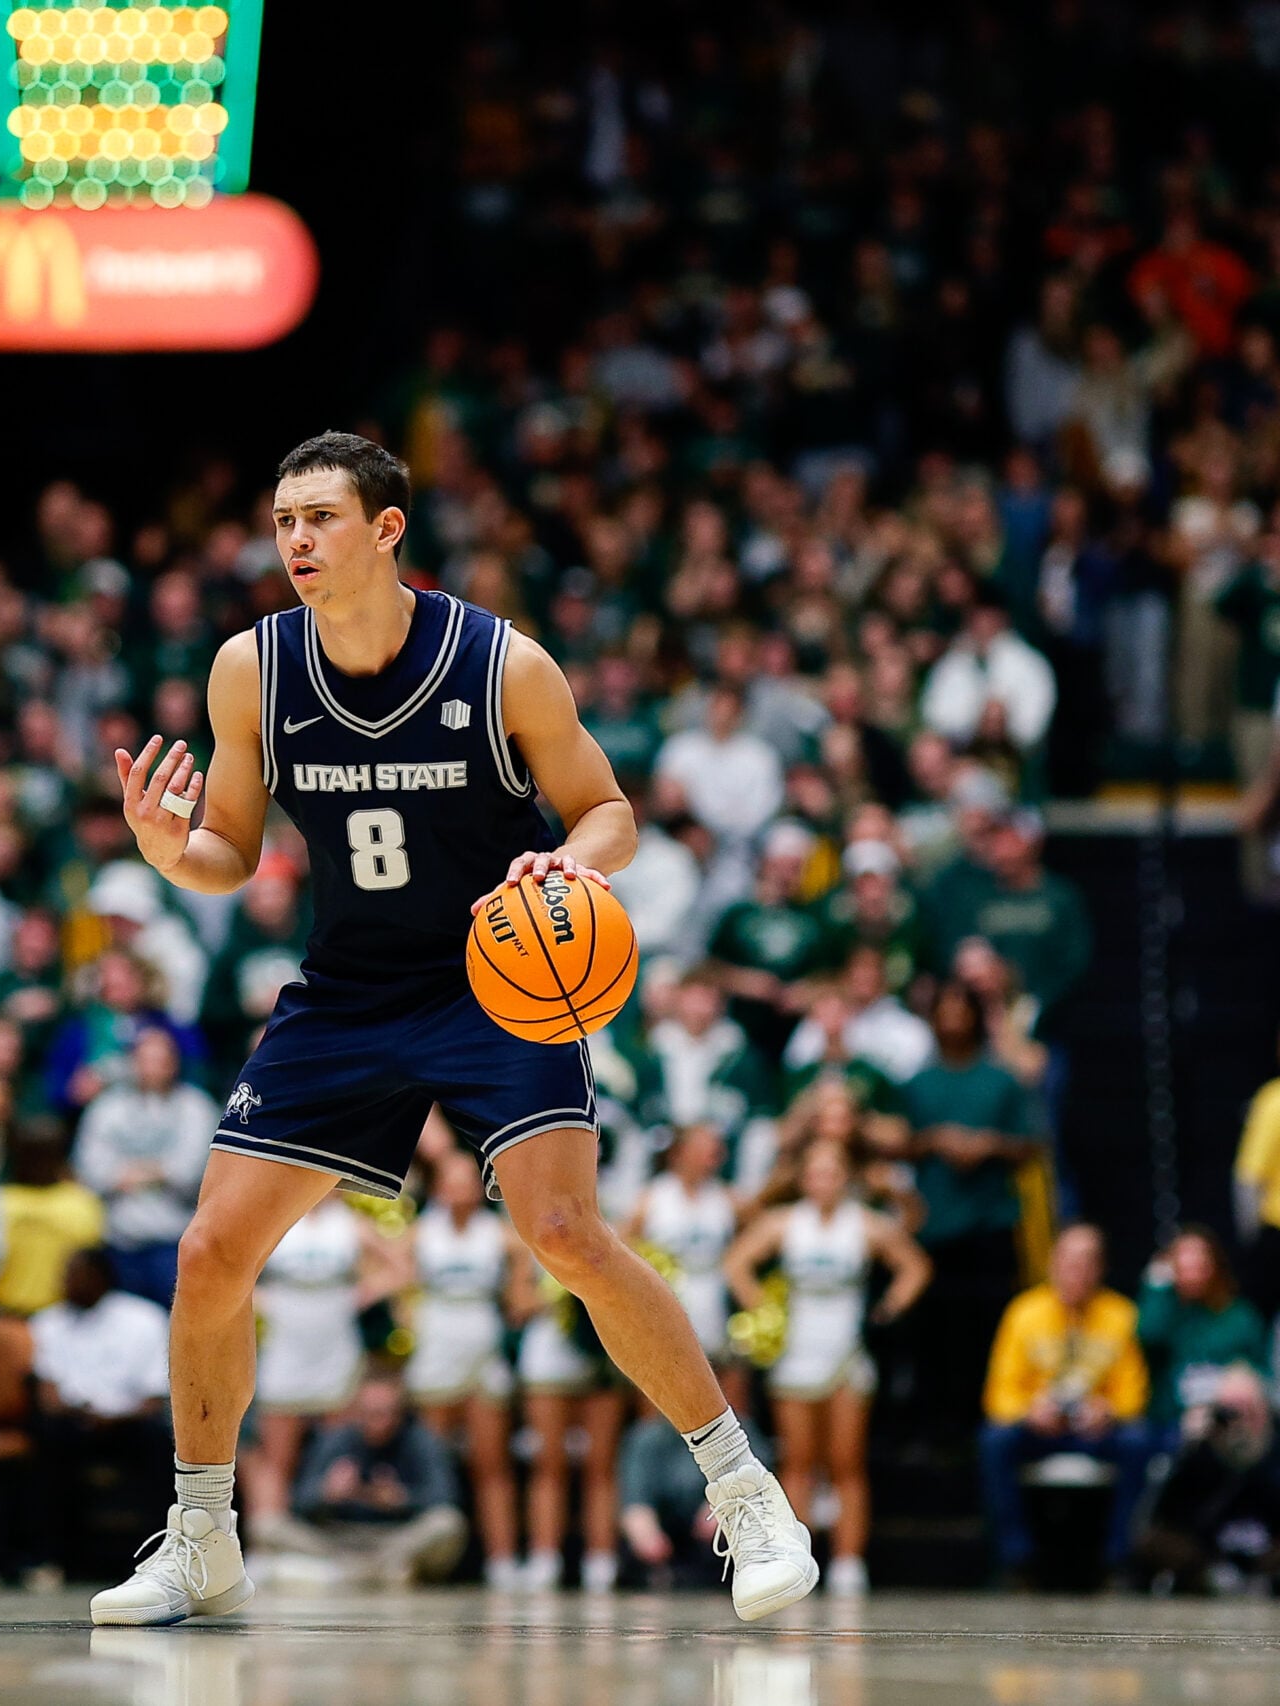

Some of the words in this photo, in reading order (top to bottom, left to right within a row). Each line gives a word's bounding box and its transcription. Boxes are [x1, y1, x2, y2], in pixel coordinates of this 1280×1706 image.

[293, 763, 372, 792] UTAH
[375, 760, 468, 791] STATE
[346, 807, 411, 891] 8
[485, 894, 517, 943] EVO
[511, 938, 530, 957] NXT
